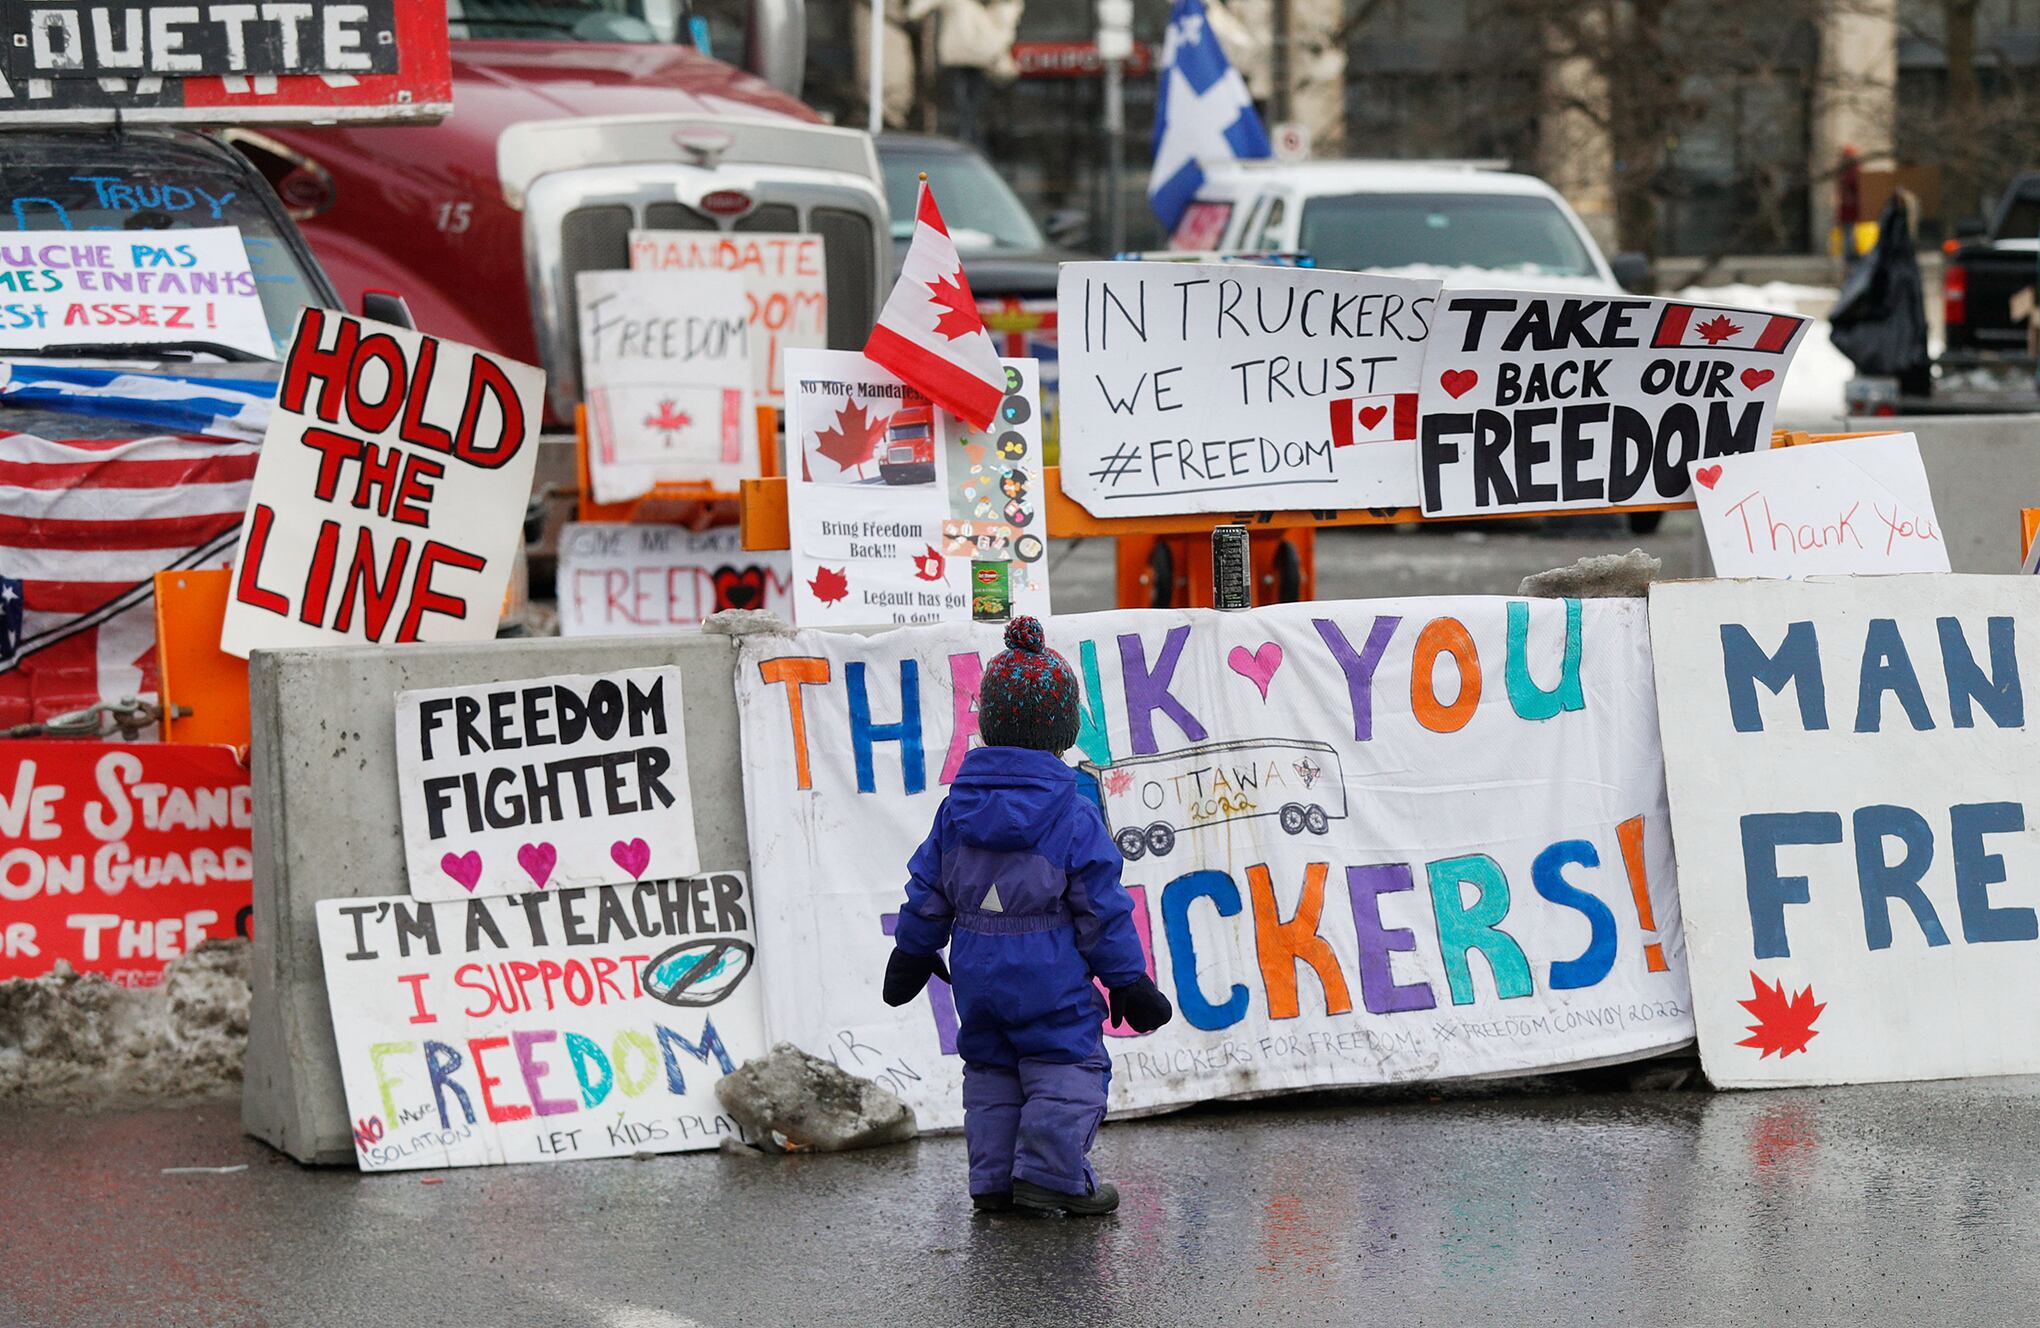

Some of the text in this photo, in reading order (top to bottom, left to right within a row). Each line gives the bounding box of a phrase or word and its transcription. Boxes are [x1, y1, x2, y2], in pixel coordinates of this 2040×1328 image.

[69, 176, 236, 220] TRUDY
[437, 201, 473, 234] 15
[131, 244, 197, 267] PAS
[628, 240, 820, 277] MANDATE
[587, 294, 749, 363] FREEDOM
[1086, 279, 1436, 352] IN TRUCKERS
[1448, 299, 1652, 352] TAKE
[280, 308, 526, 469] HOLD
[821, 382, 853, 396] More
[1096, 355, 1397, 415] WE TRUST
[1495, 358, 1735, 406] BACK OUR
[301, 427, 445, 528] THE
[1089, 438, 1334, 487] #FREEDOM
[1421, 400, 1764, 513] FREEDOM
[822, 521, 922, 538] Bring Freedom
[1725, 491, 1939, 556] Thank You
[850, 543, 897, 558] Back!!!
[864, 590, 966, 609] Legault has got
[1312, 597, 1586, 742] YOU
[1720, 616, 2025, 733] MAN
[420, 676, 667, 761] FREEDOM
[423, 746, 676, 840] FIGHTER
[1142, 761, 1287, 809] OTTAWA
[1191, 793, 1257, 820] 2022
[1740, 802, 2038, 959] FRE
[340, 874, 747, 961] I'M A TEACHER
[397, 955, 650, 1024] I SUPPORT
[369, 1012, 736, 1131] FREEDOM
[1116, 1041, 1251, 1082] TRUCKERS
[1259, 1033, 1305, 1059] FOR
[353, 1114, 384, 1153] NO
[362, 1124, 472, 1168] ISOLATION
[537, 1129, 582, 1153] LET
[607, 1116, 669, 1147] KIDS
